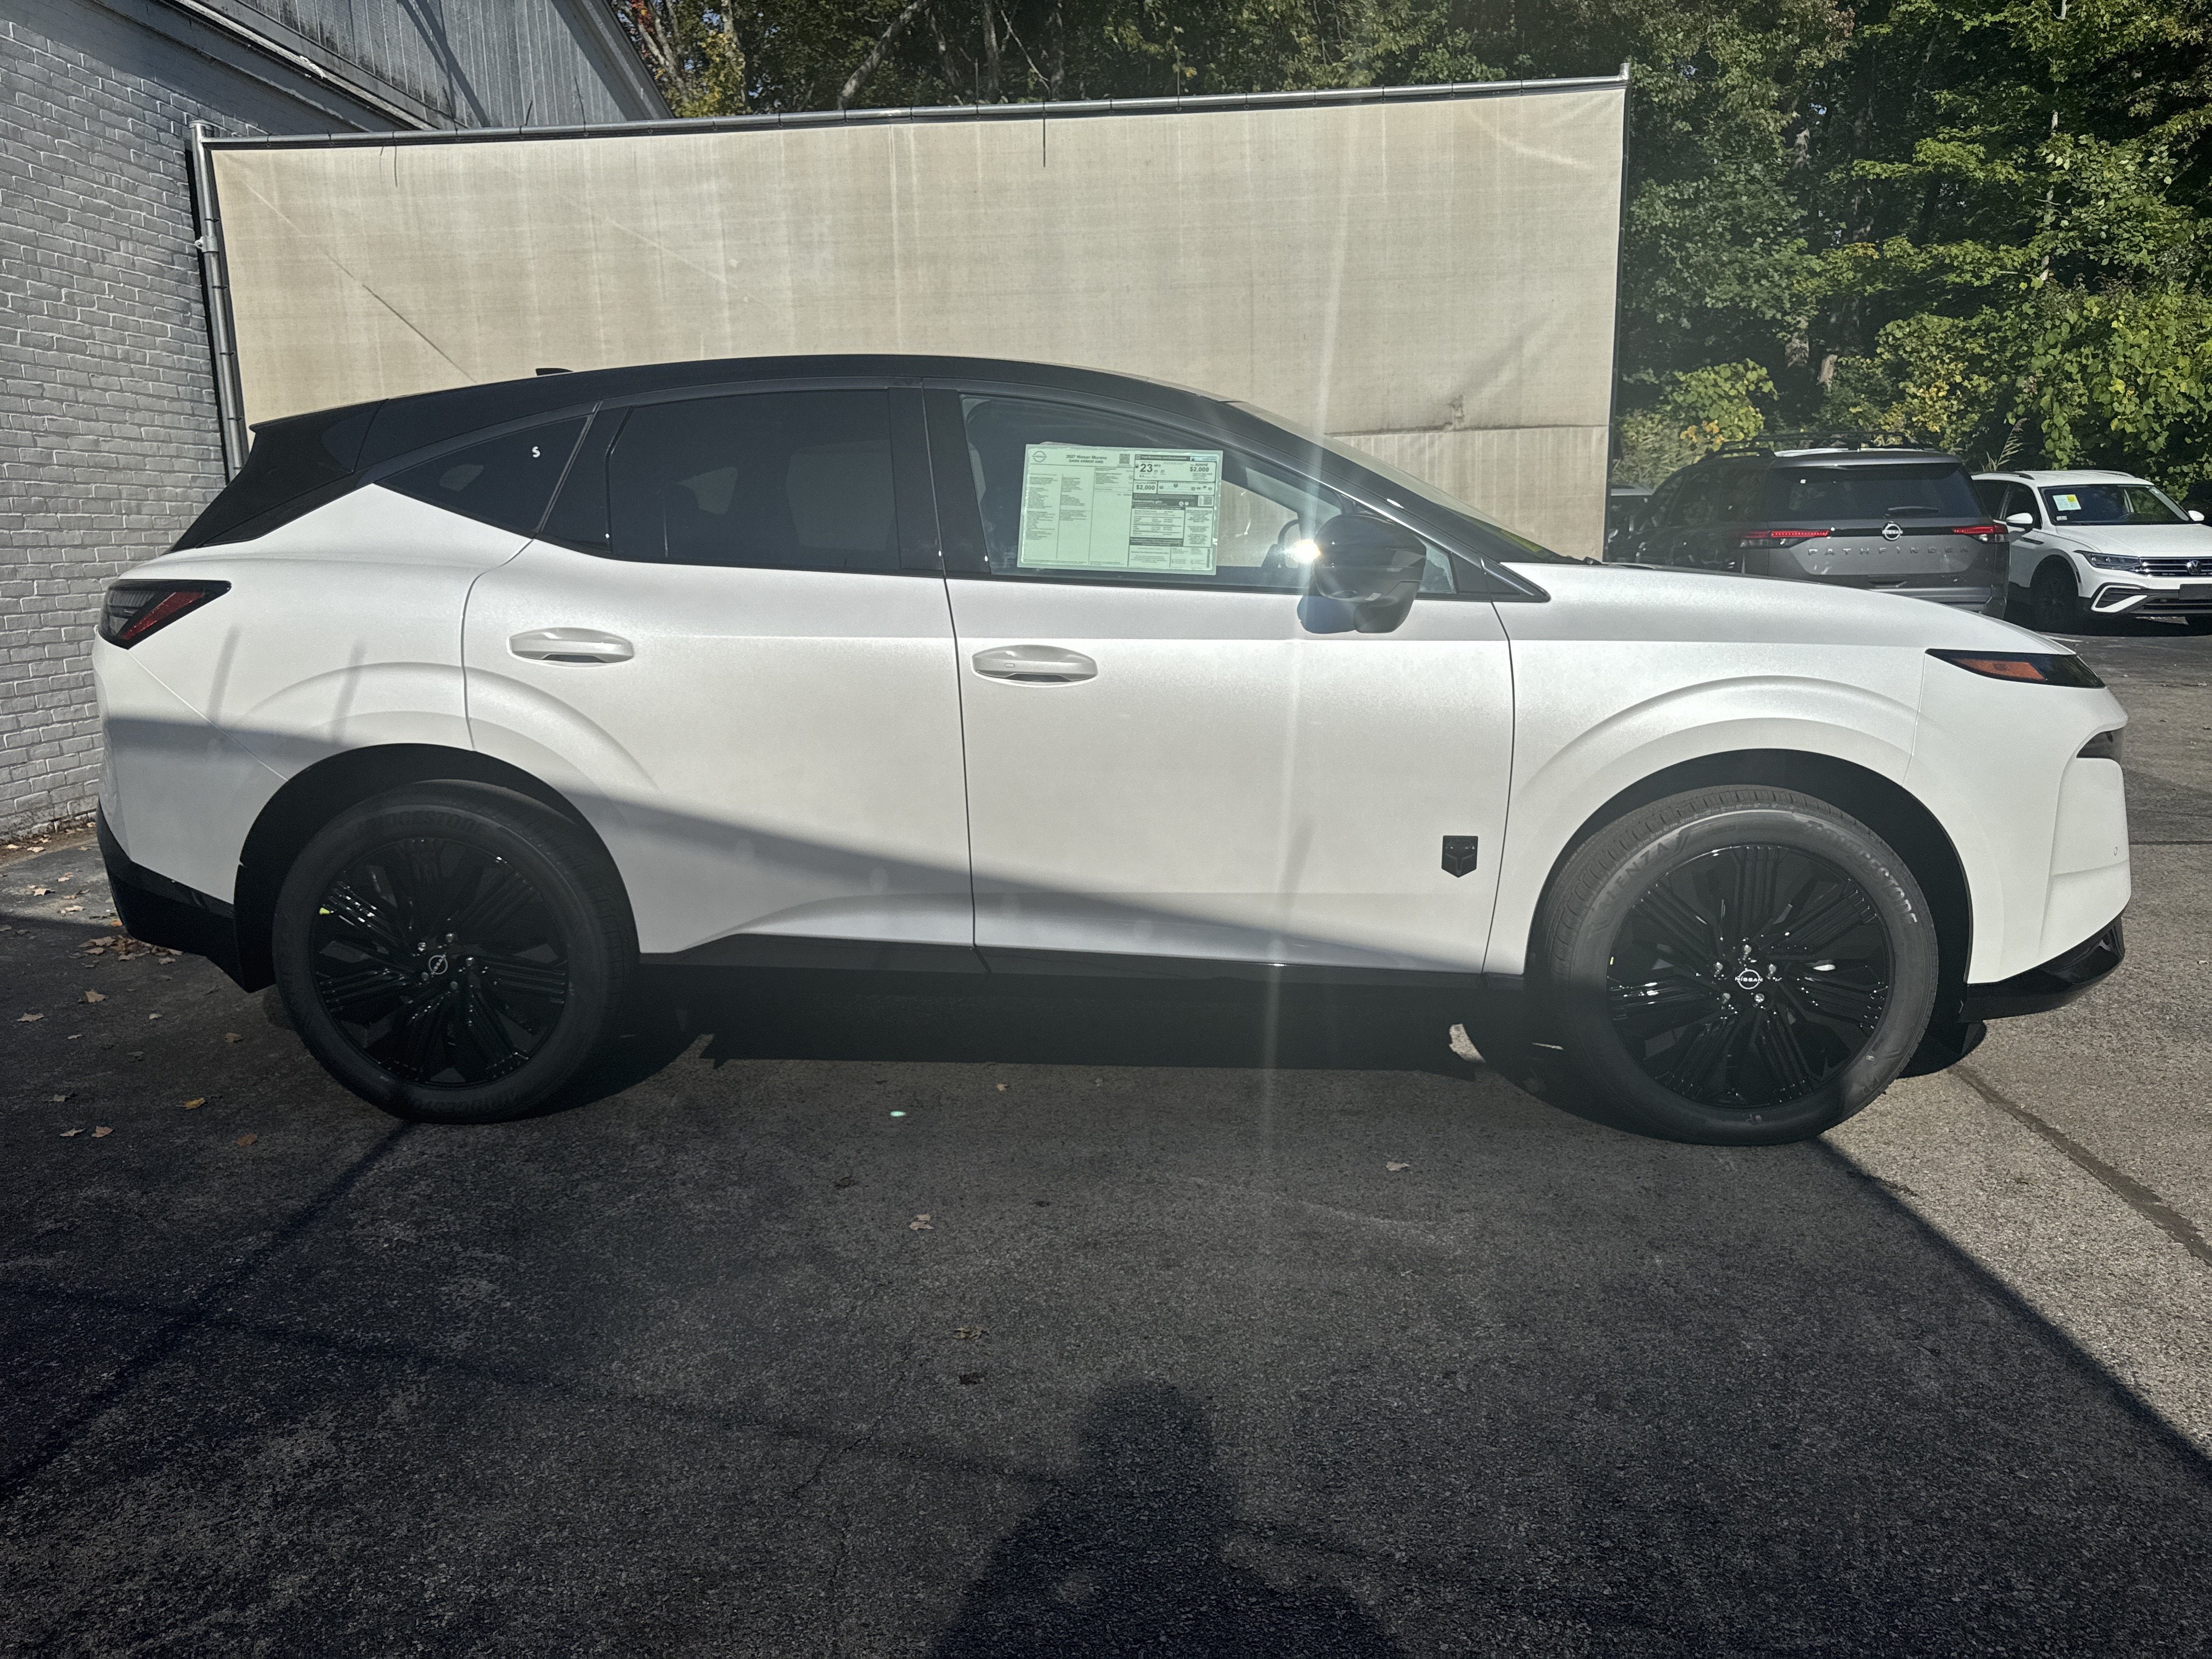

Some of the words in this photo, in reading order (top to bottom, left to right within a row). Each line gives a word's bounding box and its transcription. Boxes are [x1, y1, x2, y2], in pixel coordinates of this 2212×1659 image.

[532, 446, 540, 458] S
[1139, 463, 1153, 472] 23
[1808, 546, 1970, 556] PATHFINDER
